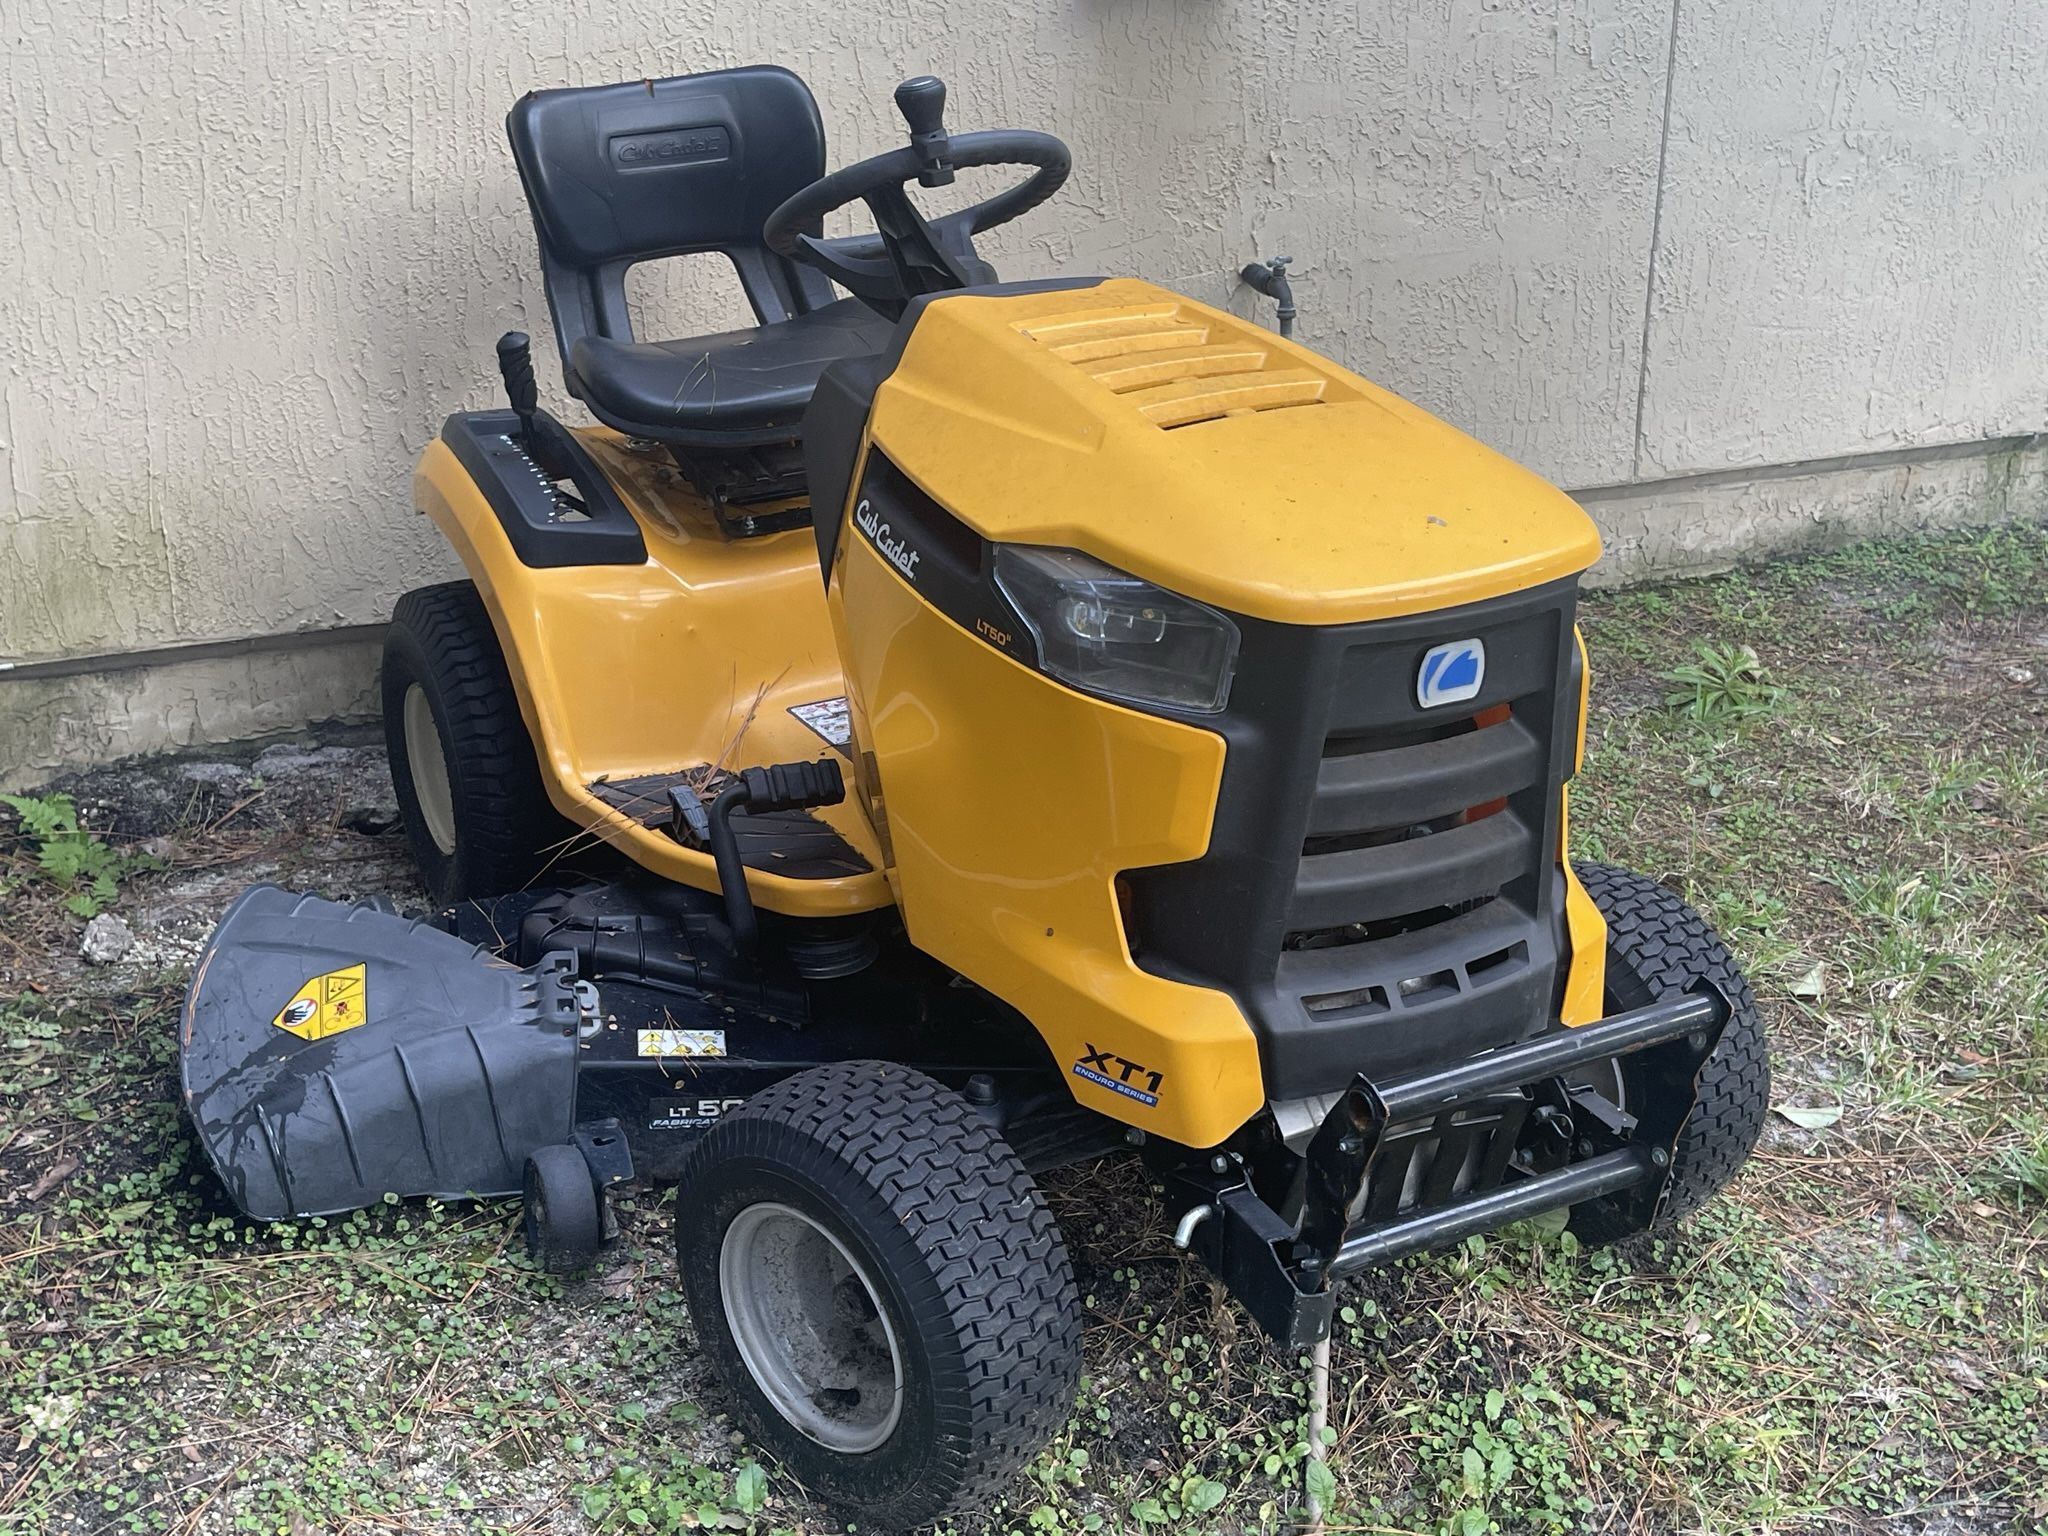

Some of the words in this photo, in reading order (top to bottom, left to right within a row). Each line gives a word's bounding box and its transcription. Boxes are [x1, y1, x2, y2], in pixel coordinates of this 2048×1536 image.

[856, 499, 879, 538] Cub
[876, 523, 920, 579] Cadet
[1075, 1066, 1115, 1087] ENDURO
[1117, 1084, 1153, 1103] SERIES
[1077, 1042, 1164, 1093] XT1
[669, 1107, 691, 1117] LT
